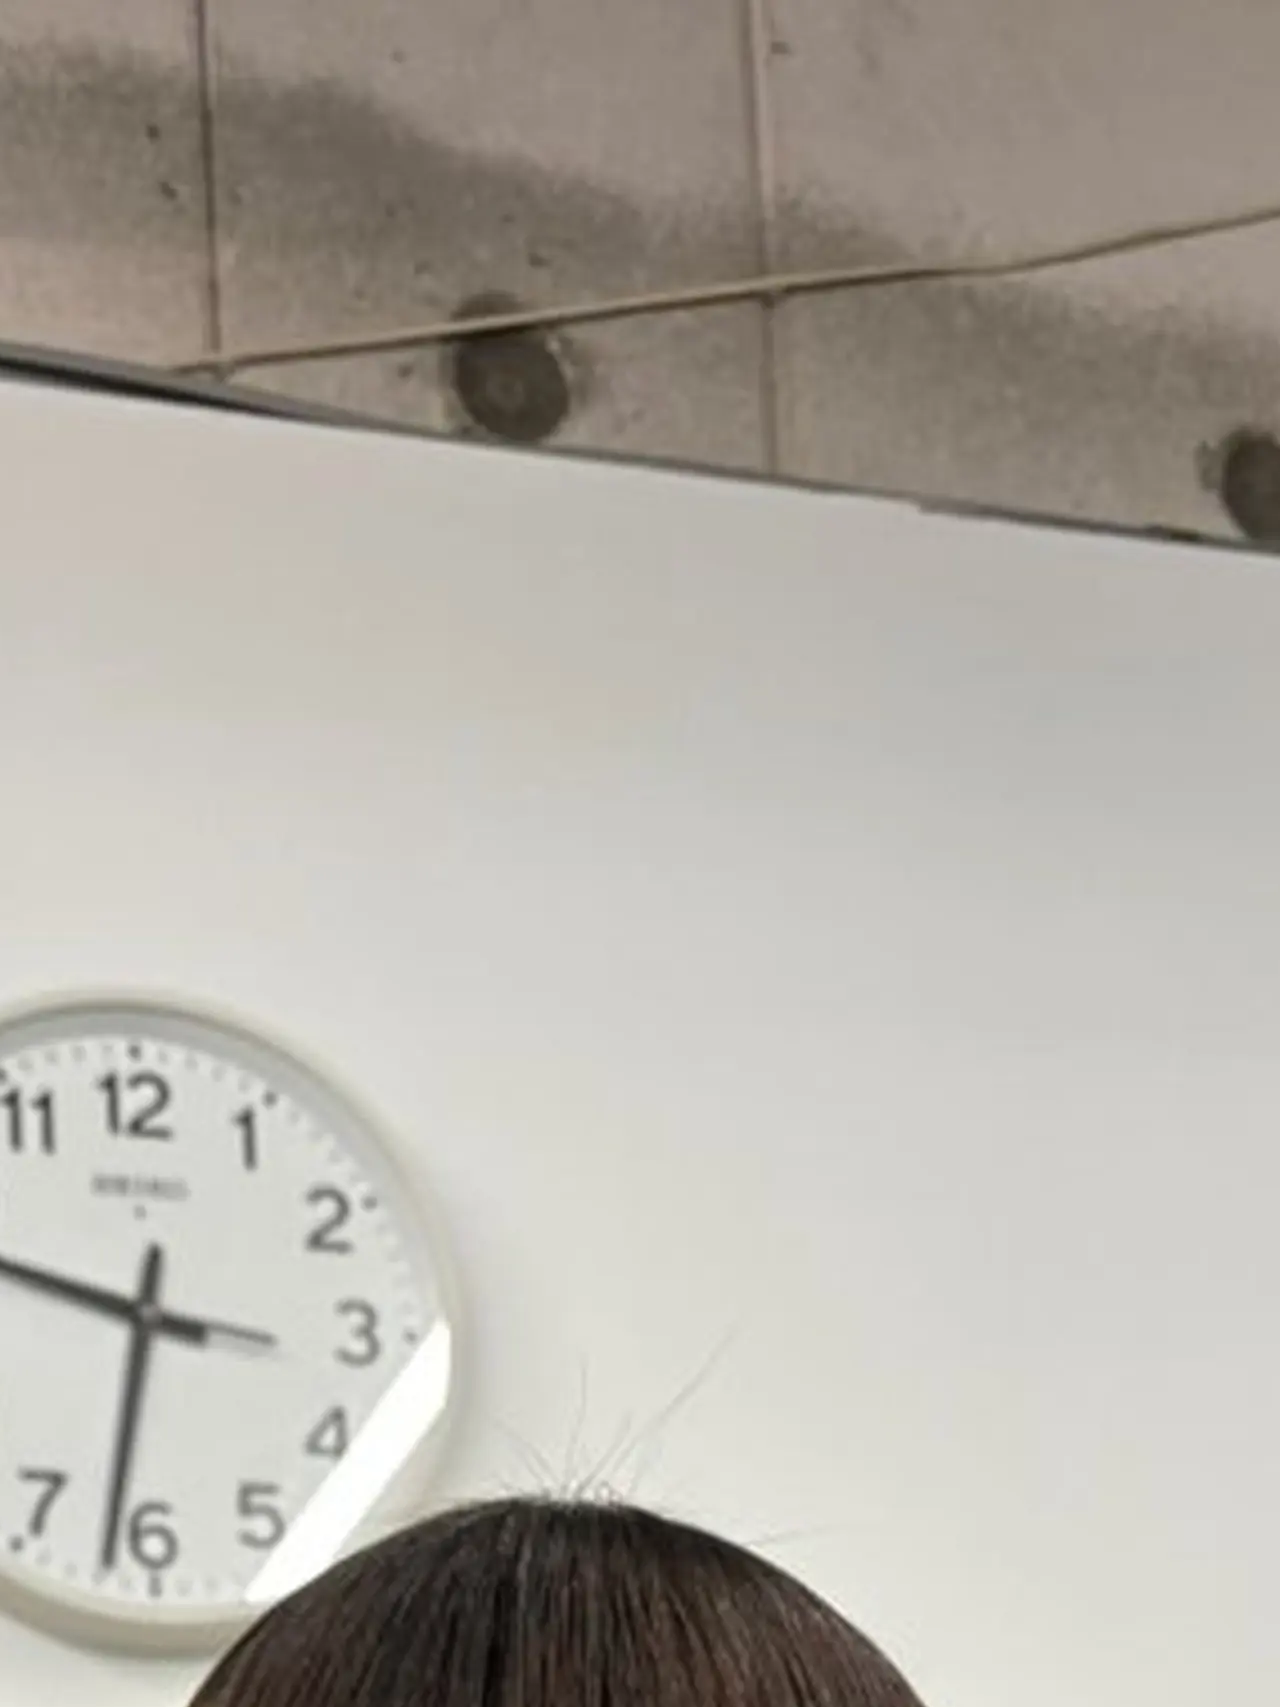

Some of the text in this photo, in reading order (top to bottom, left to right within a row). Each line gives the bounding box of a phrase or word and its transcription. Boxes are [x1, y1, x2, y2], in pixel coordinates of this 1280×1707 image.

[97, 1071, 173, 1141] 12
[233, 1106, 257, 1171] 1
[305, 1187, 352, 1255] 2
[333, 1299, 381, 1367] 3
[304, 1406, 348, 1460] 4
[20, 1469, 68, 1537] 7
[128, 1500, 179, 1570] 6
[236, 1481, 286, 1550] 5
